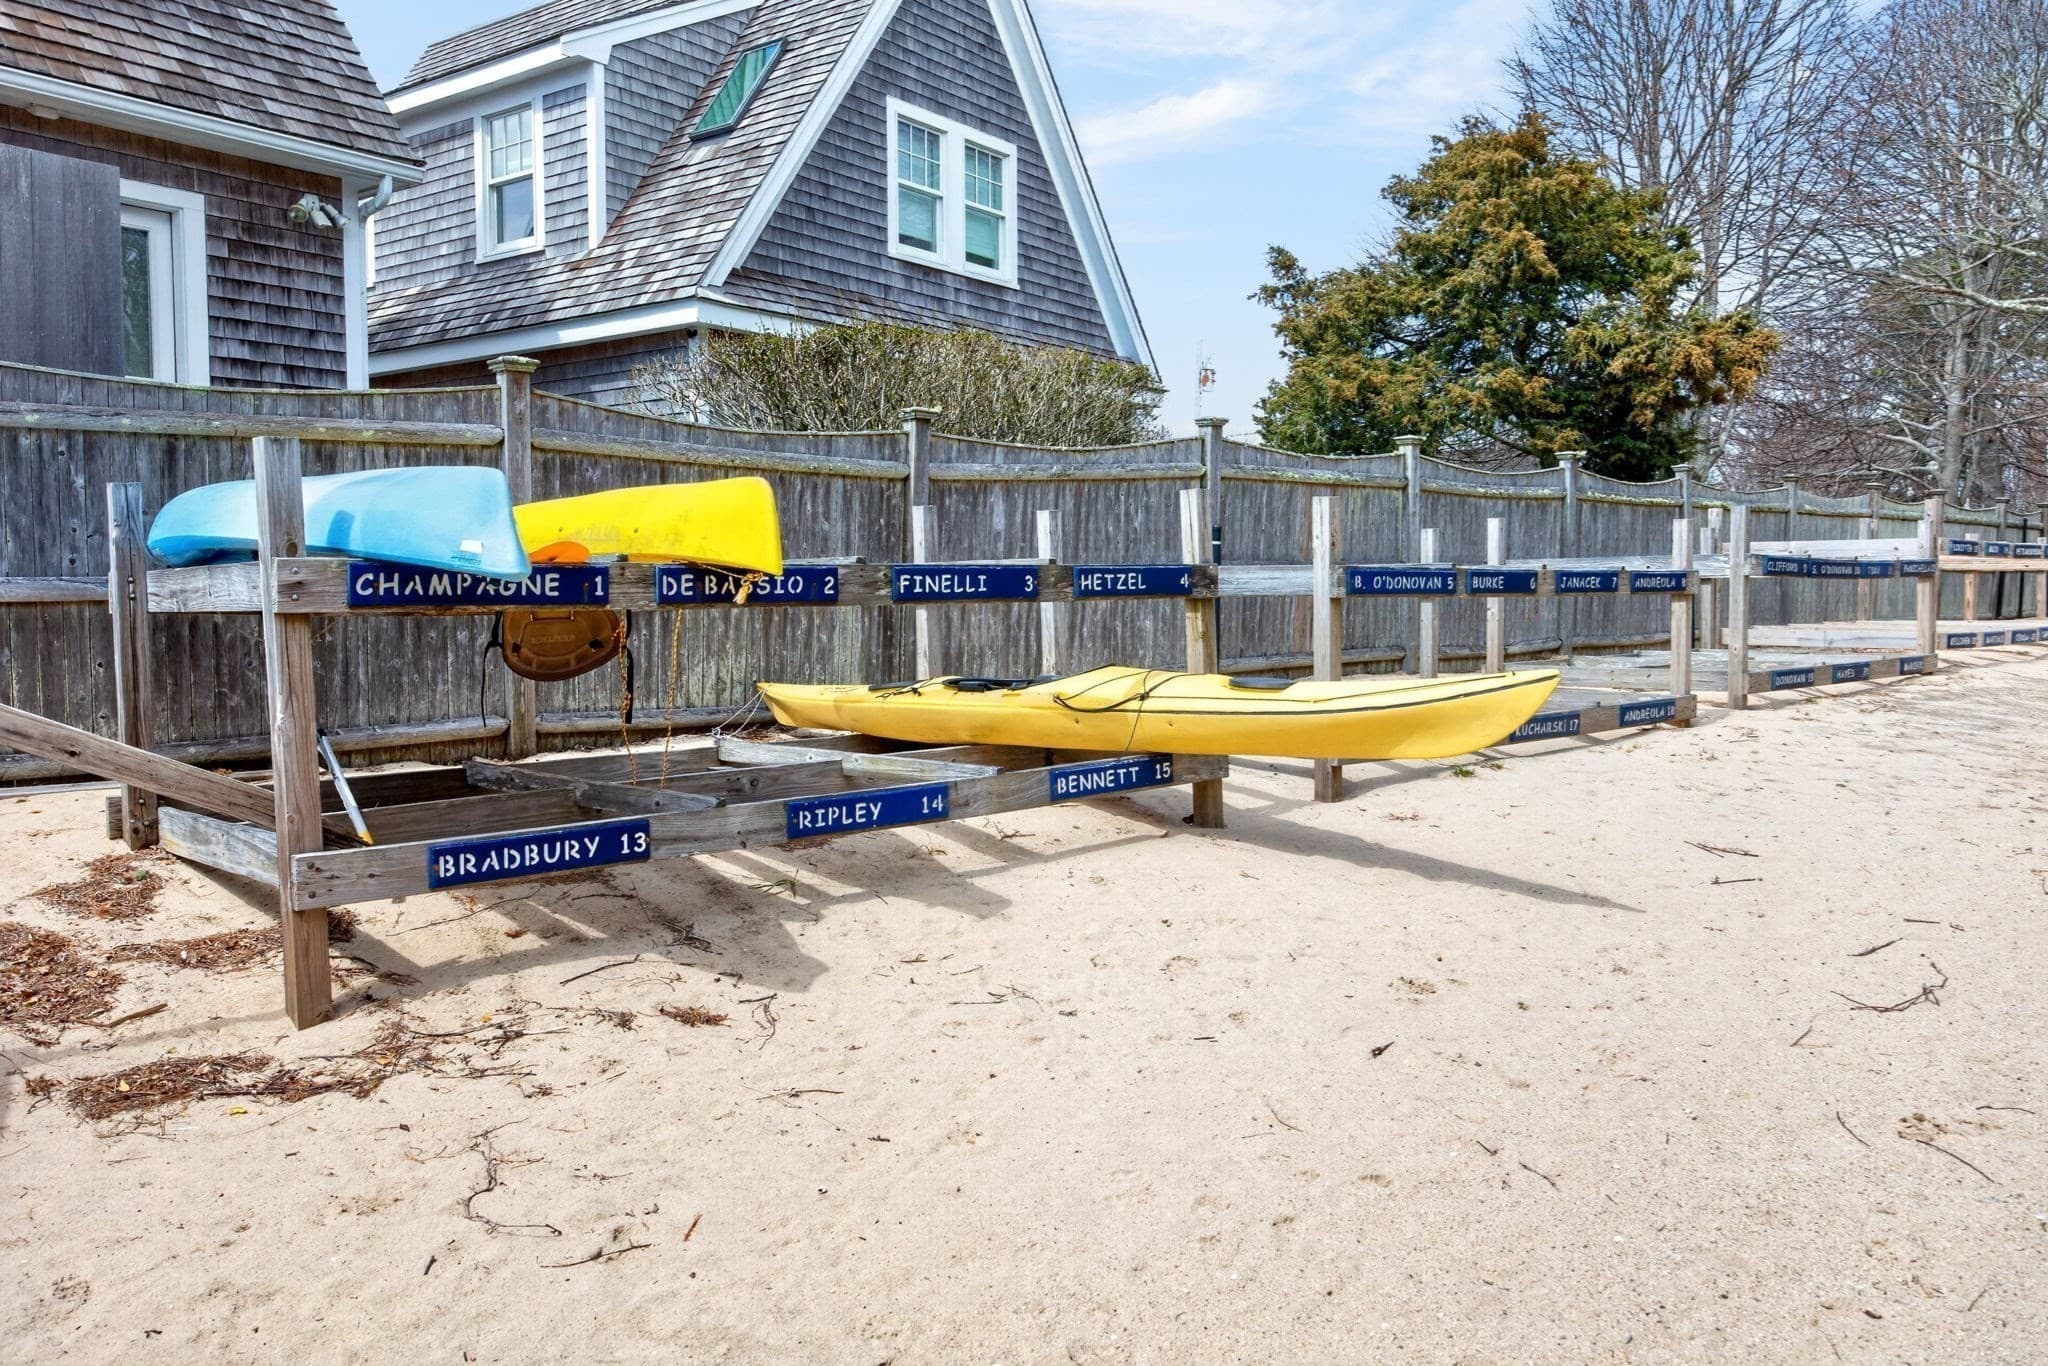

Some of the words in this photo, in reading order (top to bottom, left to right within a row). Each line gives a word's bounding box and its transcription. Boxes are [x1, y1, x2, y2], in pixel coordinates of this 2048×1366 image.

[1767, 561, 1798, 573] CLIFFORD
[355, 573, 560, 597] CHAMPAGNE
[594, 576, 605, 596] 1
[662, 574, 694, 596] DE
[823, 576, 835, 594] 2
[900, 574, 988, 594] FINELLI
[1024, 574, 1034, 592] 3
[1081, 573, 1147, 591] HETZEL
[1180, 572, 1190, 589] 4
[1354, 575, 1367, 590] B.
[1373, 575, 1442, 590] O'DONOVAN
[1447, 576, 1454, 590] 5
[1472, 576, 1505, 589] BURKE
[1529, 576, 1537, 590] 6
[1560, 576, 1601, 589] JANACEK
[1611, 577, 1617, 589] 7
[1635, 576, 1676, 588] ANDREOLA
[1623, 706, 1665, 722] ANDREOLA
[1569, 719, 1579, 731] 17
[1057, 766, 1139, 794] BENNETT
[1155, 762, 1171, 779] 15
[799, 802, 882, 829] RIPLEY
[922, 794, 944, 814] 14
[438, 835, 600, 878] BRADBURY
[620, 832, 647, 854] 13
